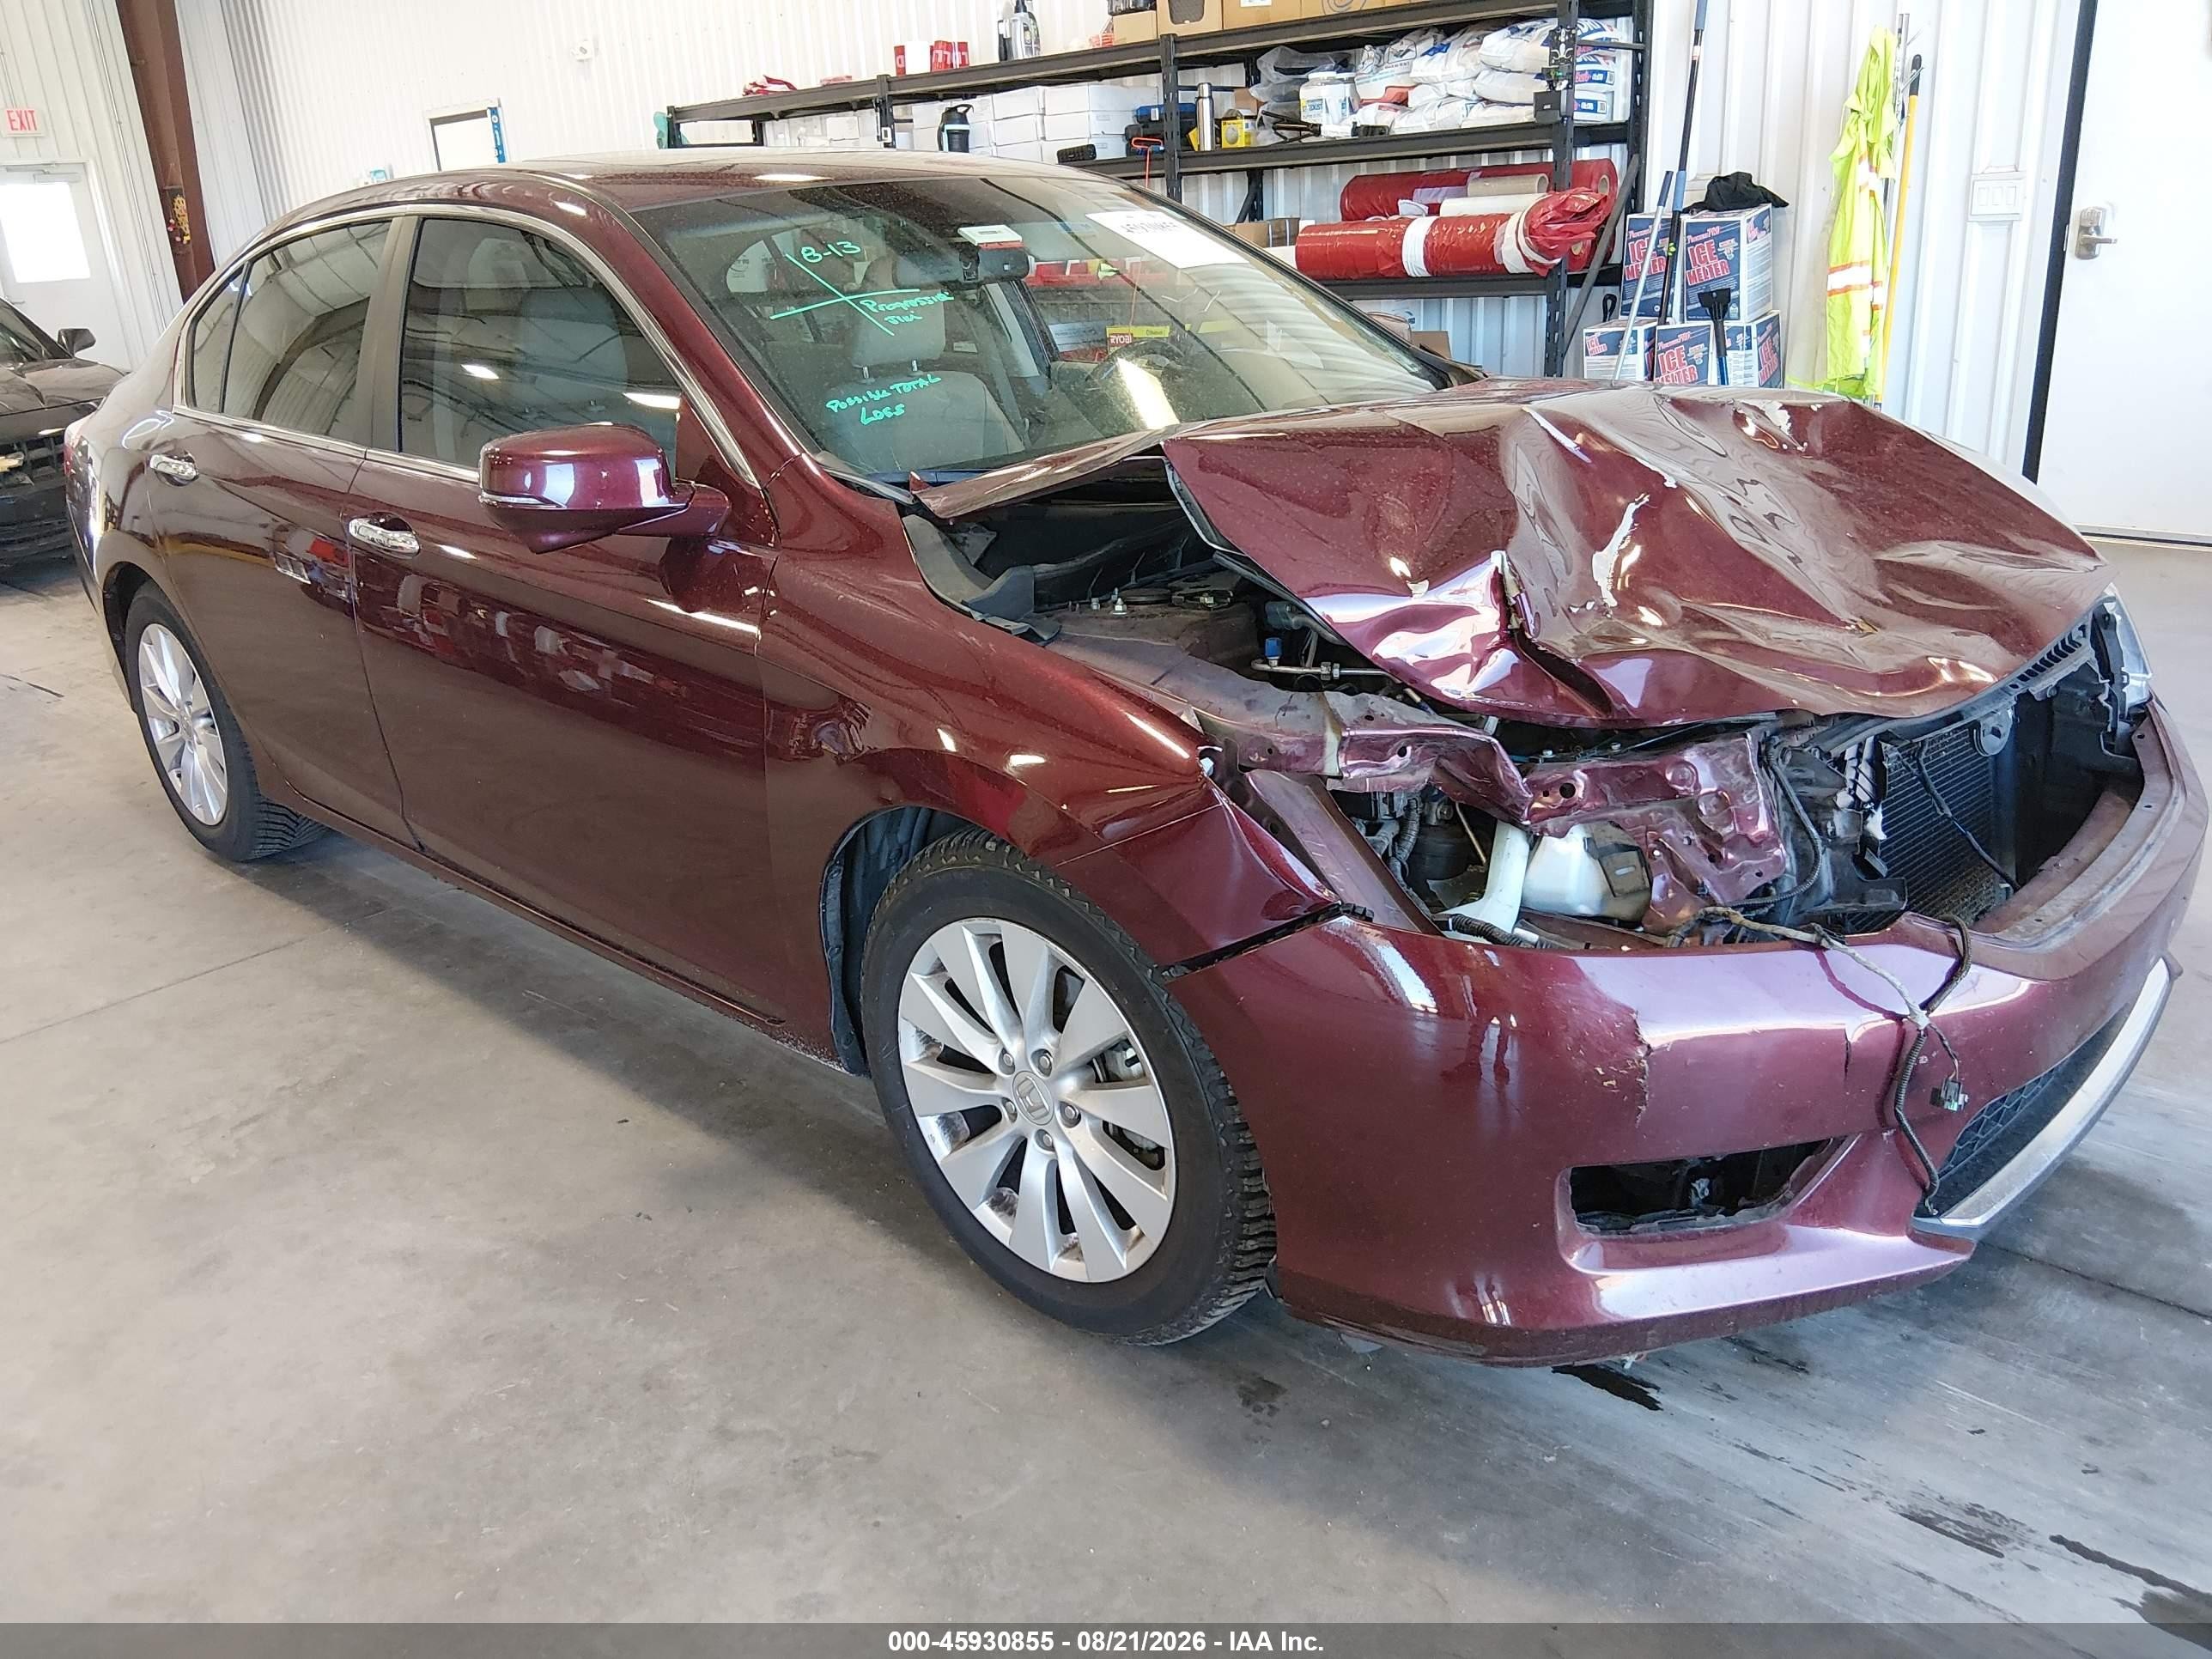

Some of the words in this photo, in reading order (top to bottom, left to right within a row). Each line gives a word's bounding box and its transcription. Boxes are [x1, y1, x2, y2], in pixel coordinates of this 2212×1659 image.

[6, 109, 38, 131] EXIT
[1687, 239, 1719, 269] ICE
[1624, 256, 1667, 282] MEER
[1686, 258, 1731, 287] MELTER
[1109, 334, 1133, 344] RYOBI
[1657, 344, 1688, 374] ICE
